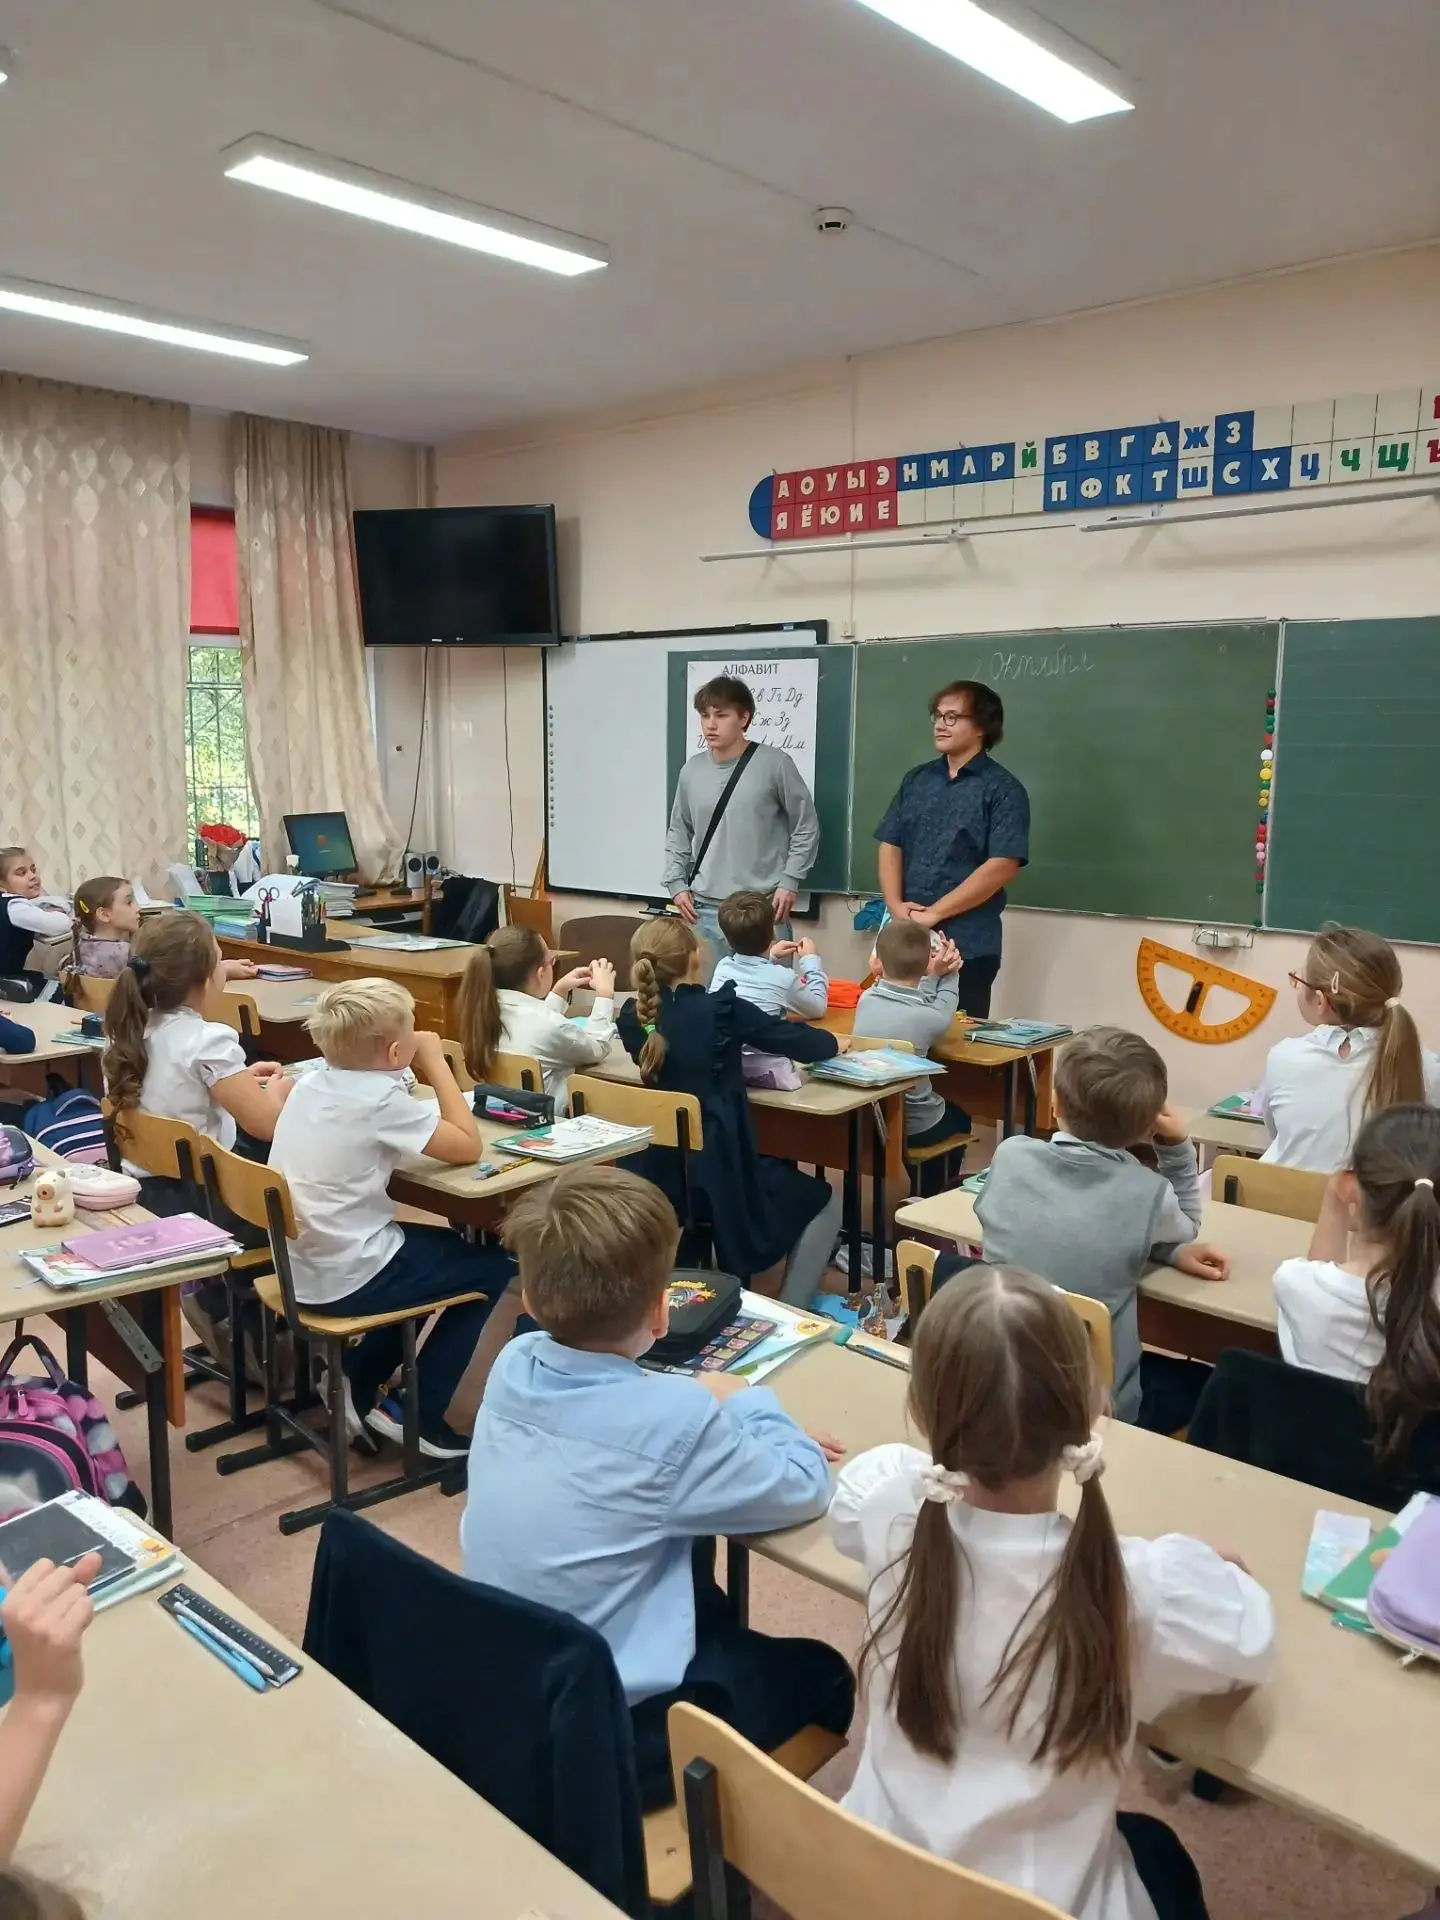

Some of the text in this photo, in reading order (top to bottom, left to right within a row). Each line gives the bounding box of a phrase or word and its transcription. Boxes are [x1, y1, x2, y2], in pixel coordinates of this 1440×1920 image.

[776, 511, 788, 531] Я
[801, 504, 812, 528] Ё
[820, 505, 841, 525] Ю
[849, 503, 864, 523] И
[877, 499, 890, 520] Е
[1050, 480, 1067, 502] П
[1080, 477, 1102, 499] Ф
[1115, 473, 1131, 496] К
[1152, 469, 1168, 492] Т
[1182, 466, 1208, 489] Ш
[1222, 461, 1241, 485] С
[1261, 457, 1280, 481] Х
[1300, 453, 1320, 480] Ц
[1341, 448, 1361, 472] Ч
[1378, 442, 1409, 472] Щ
[777, 421, 1241, 498] А О У Ы Э Н М Л Р Й Б В Г Д Ж З
[722, 663, 780, 675] АЛФАВИТ
